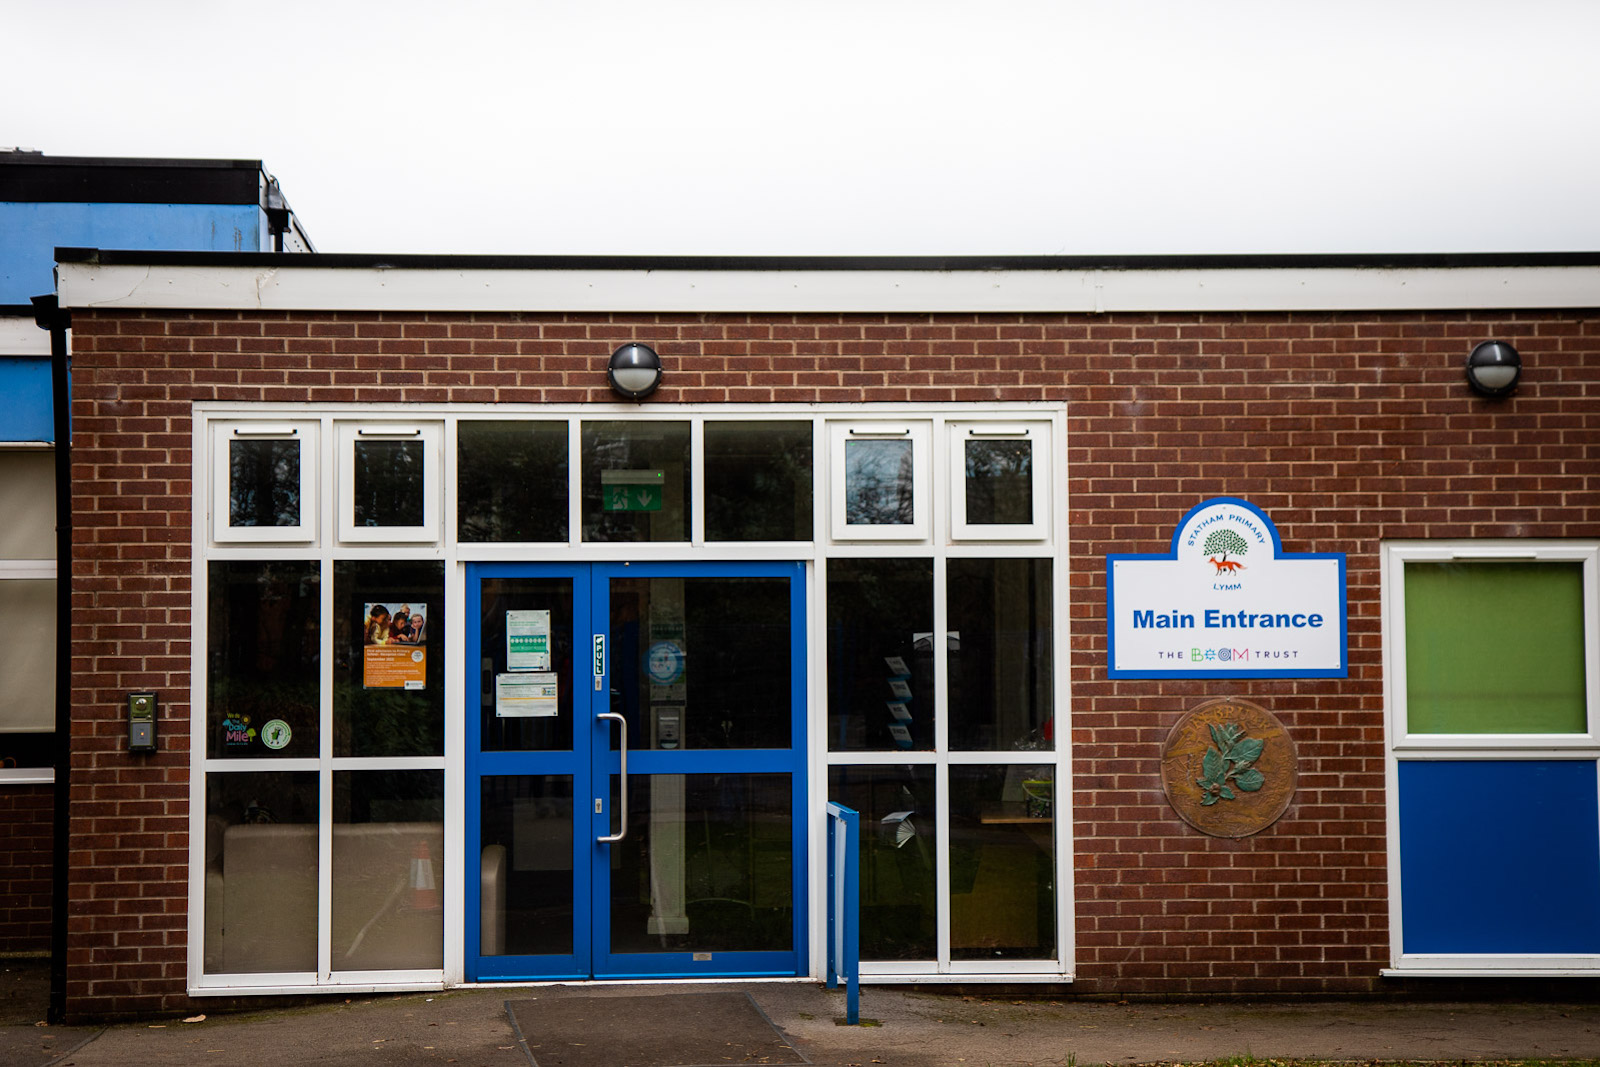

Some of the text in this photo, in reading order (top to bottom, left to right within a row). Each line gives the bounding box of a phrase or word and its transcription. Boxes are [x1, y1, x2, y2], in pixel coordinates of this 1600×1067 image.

[1188, 514, 1265, 546] STATHAM PRIMARY
[1133, 610, 1323, 628] Main Entrance
[228, 723, 247, 732] Daily
[226, 731, 249, 742] Mile
